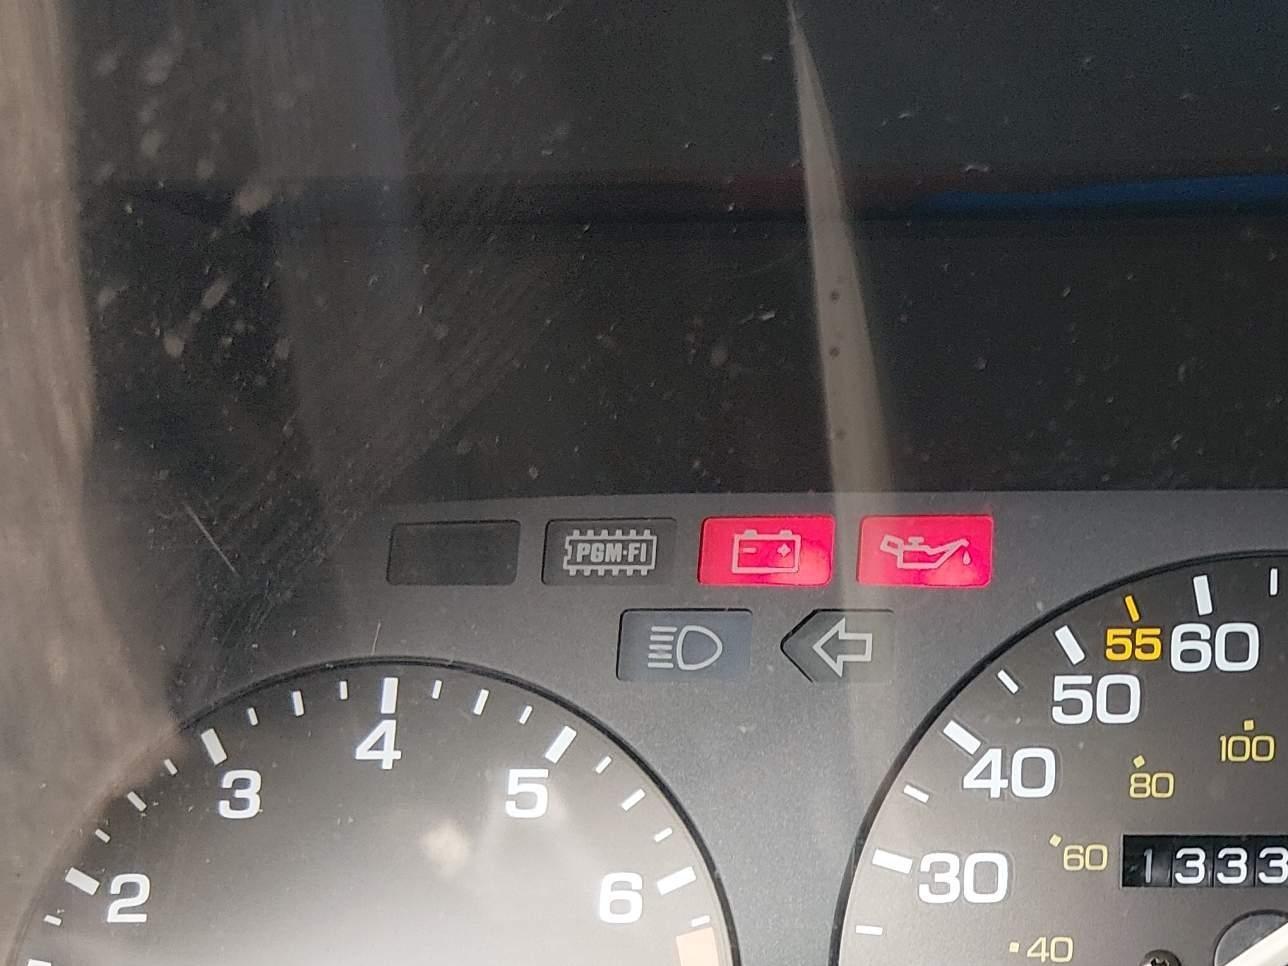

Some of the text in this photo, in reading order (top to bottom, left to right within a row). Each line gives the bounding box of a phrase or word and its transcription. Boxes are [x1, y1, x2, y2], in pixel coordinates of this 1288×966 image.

[1105, 627, 1162, 662] 55
[1169, 623, 1260, 673] 60
[1051, 674, 1142, 725] 50
[354, 720, 402, 770] 4
[1219, 734, 1277, 763] 100
[217, 769, 263, 820] 3
[504, 768, 549, 817] 5
[961, 747, 1057, 799] 40
[1128, 772, 1176, 799] 80
[918, 852, 1010, 904] 30
[1061, 844, 1109, 872] 60
[106, 873, 152, 923] 2
[598, 871, 643, 923] 6
[1026, 936, 1074, 963] 40
